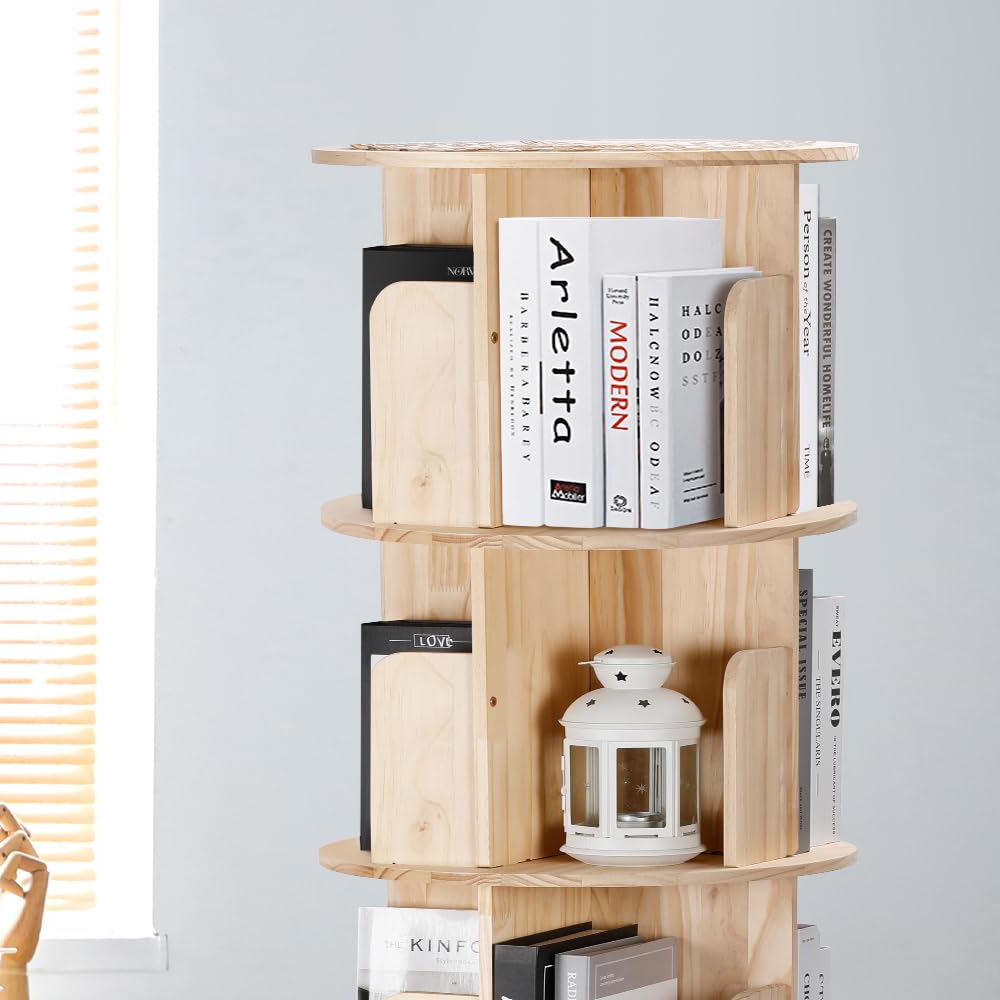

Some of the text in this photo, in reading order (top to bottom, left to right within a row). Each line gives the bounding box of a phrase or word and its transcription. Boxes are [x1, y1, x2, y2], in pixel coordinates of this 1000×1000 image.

[803, 210, 811, 279] Person
[803, 281, 809, 292] of
[549, 237, 578, 443] Arletta
[609, 320, 629, 431] MODERN
[803, 311, 811, 357] Year
[822, 229, 832, 428] CREATE WONDERFUL HOMELIFE
[799, 589, 808, 699] SPECIAL ISSUE
[831, 631, 841, 728] EVERO
